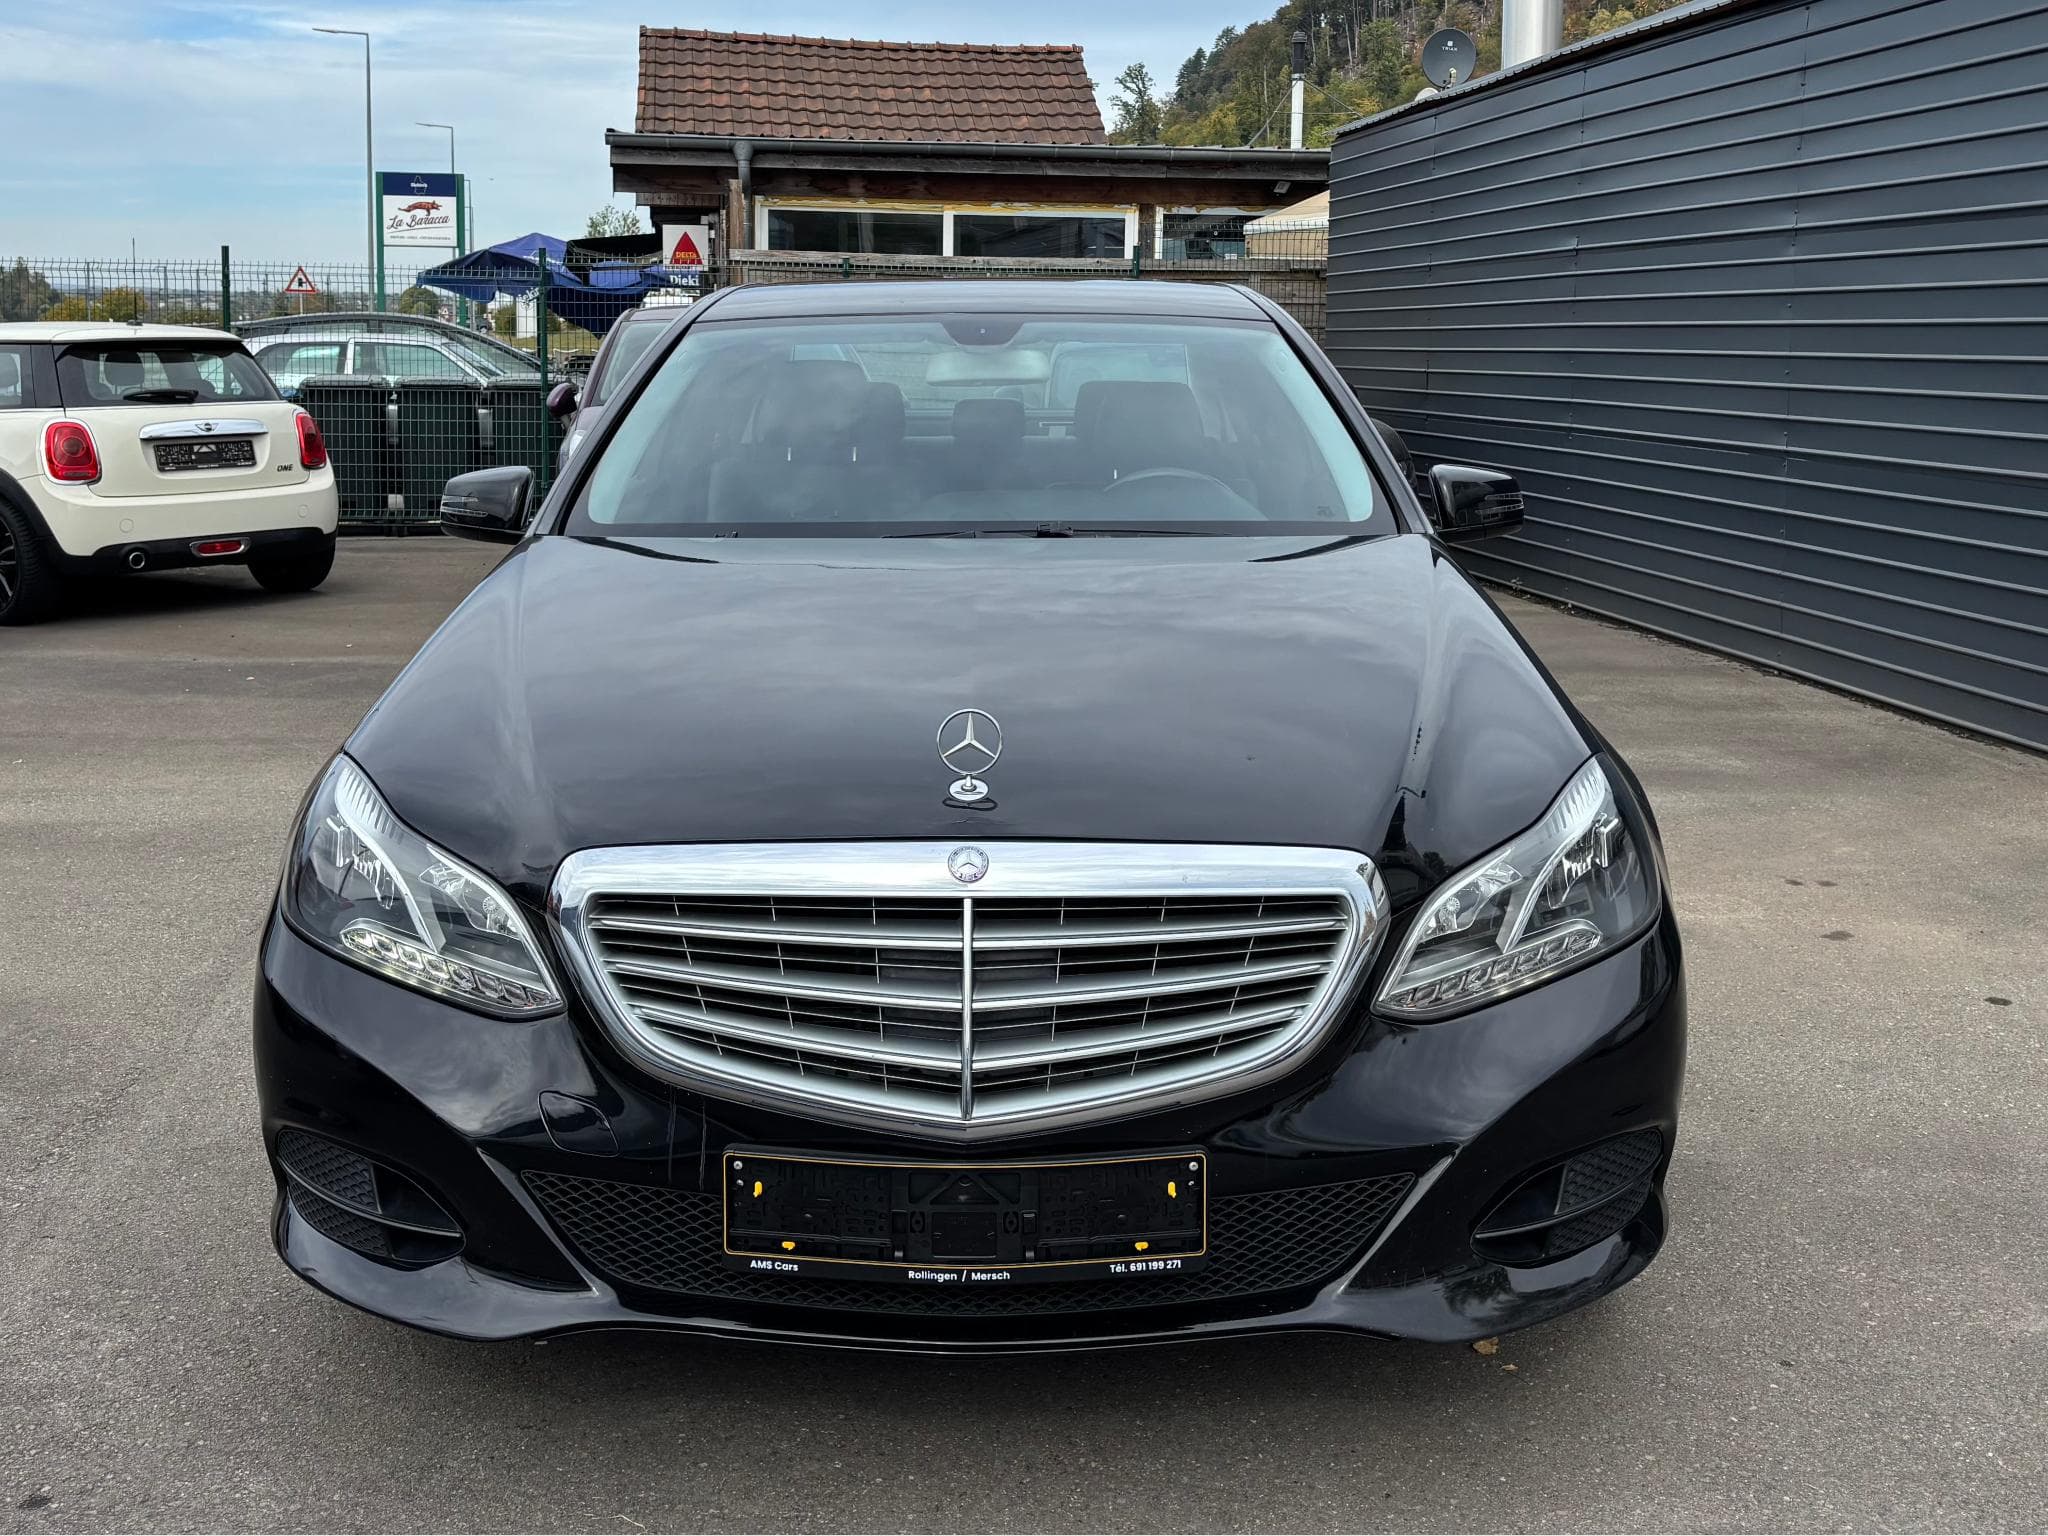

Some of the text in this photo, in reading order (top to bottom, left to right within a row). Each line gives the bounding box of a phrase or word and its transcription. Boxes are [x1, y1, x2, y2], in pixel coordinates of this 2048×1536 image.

[386, 214, 451, 230] La Baracca
[277, 464, 294, 472] ONE
[750, 1260, 799, 1272] AMS Cars
[1109, 1259, 1182, 1273] Tél. 691 199 271
[908, 1269, 1010, 1283] Rollingen / Mersch
